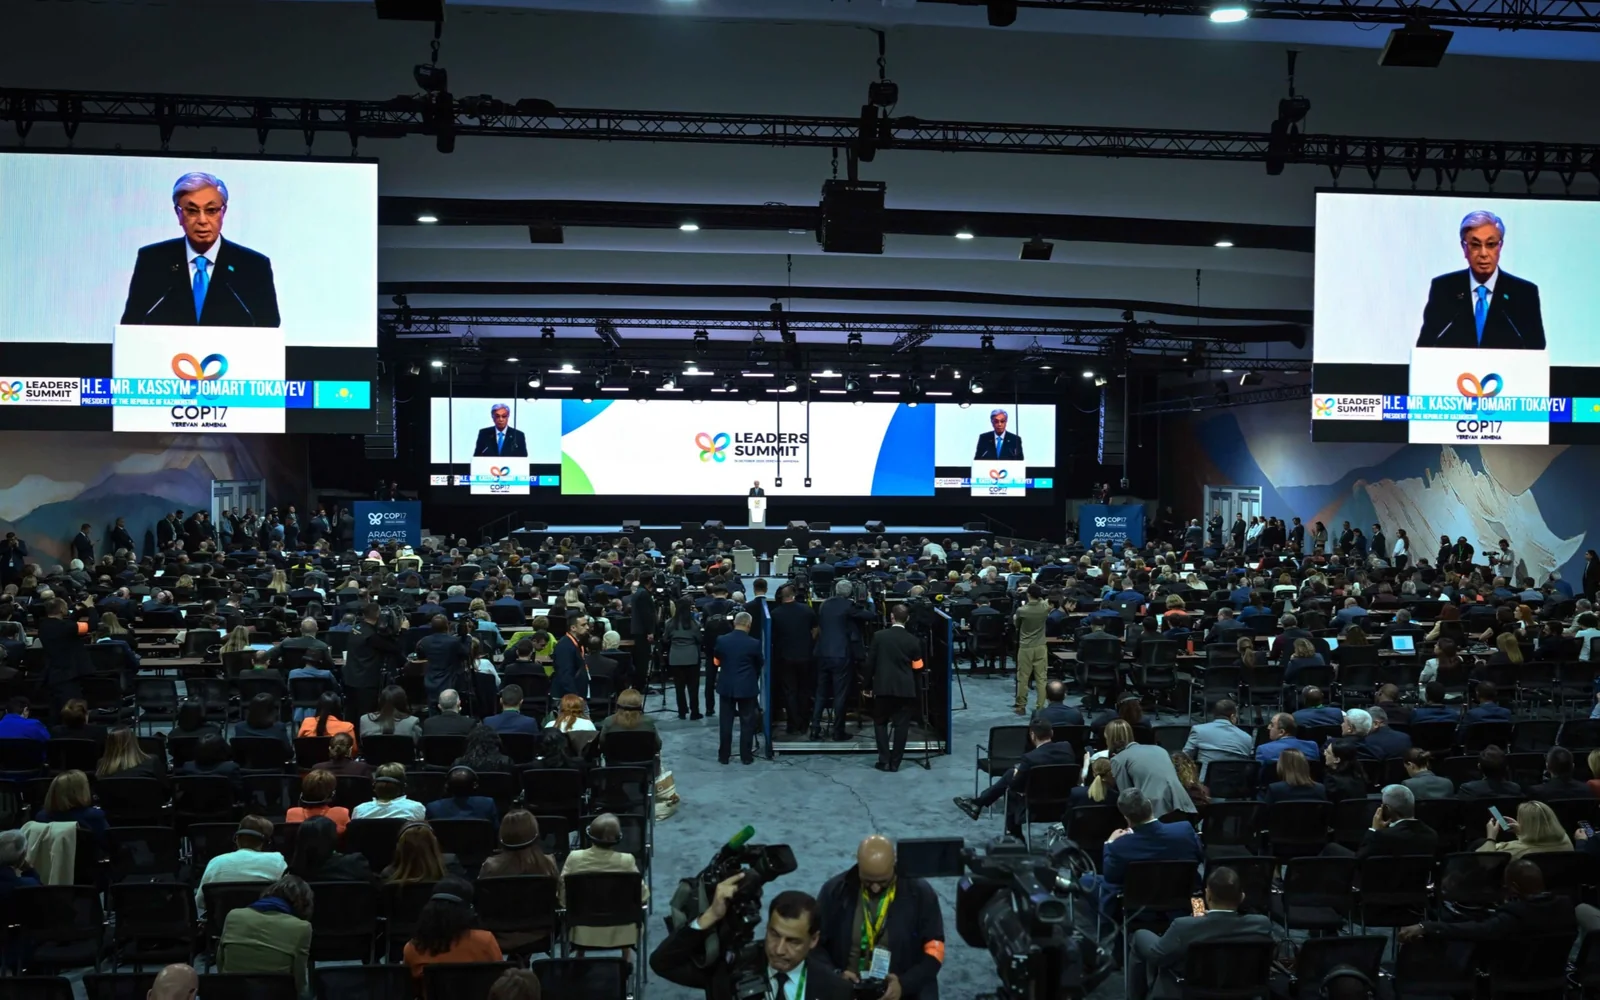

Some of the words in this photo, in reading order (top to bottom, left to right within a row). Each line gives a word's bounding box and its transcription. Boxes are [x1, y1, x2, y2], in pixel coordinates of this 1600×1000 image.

[26, 381, 78, 389] LEADERS
[82, 378, 106, 394] H.E.
[110, 379, 133, 395] MR.
[137, 379, 246, 396] KASSYM-JOMART
[249, 380, 306, 397] TOKAYEV
[26, 389, 72, 398] SUMMIT
[1383, 395, 1404, 410] H.E.
[1407, 396, 1426, 410] MR.
[1429, 396, 1517, 411] KASSYM-JOMART
[1520, 397, 1566, 412] TOKAYEV
[171, 405, 228, 420] COP17
[1456, 420, 1502, 433] COP17
[735, 432, 808, 444] LEADERS
[734, 445, 799, 457] SUMMIT
